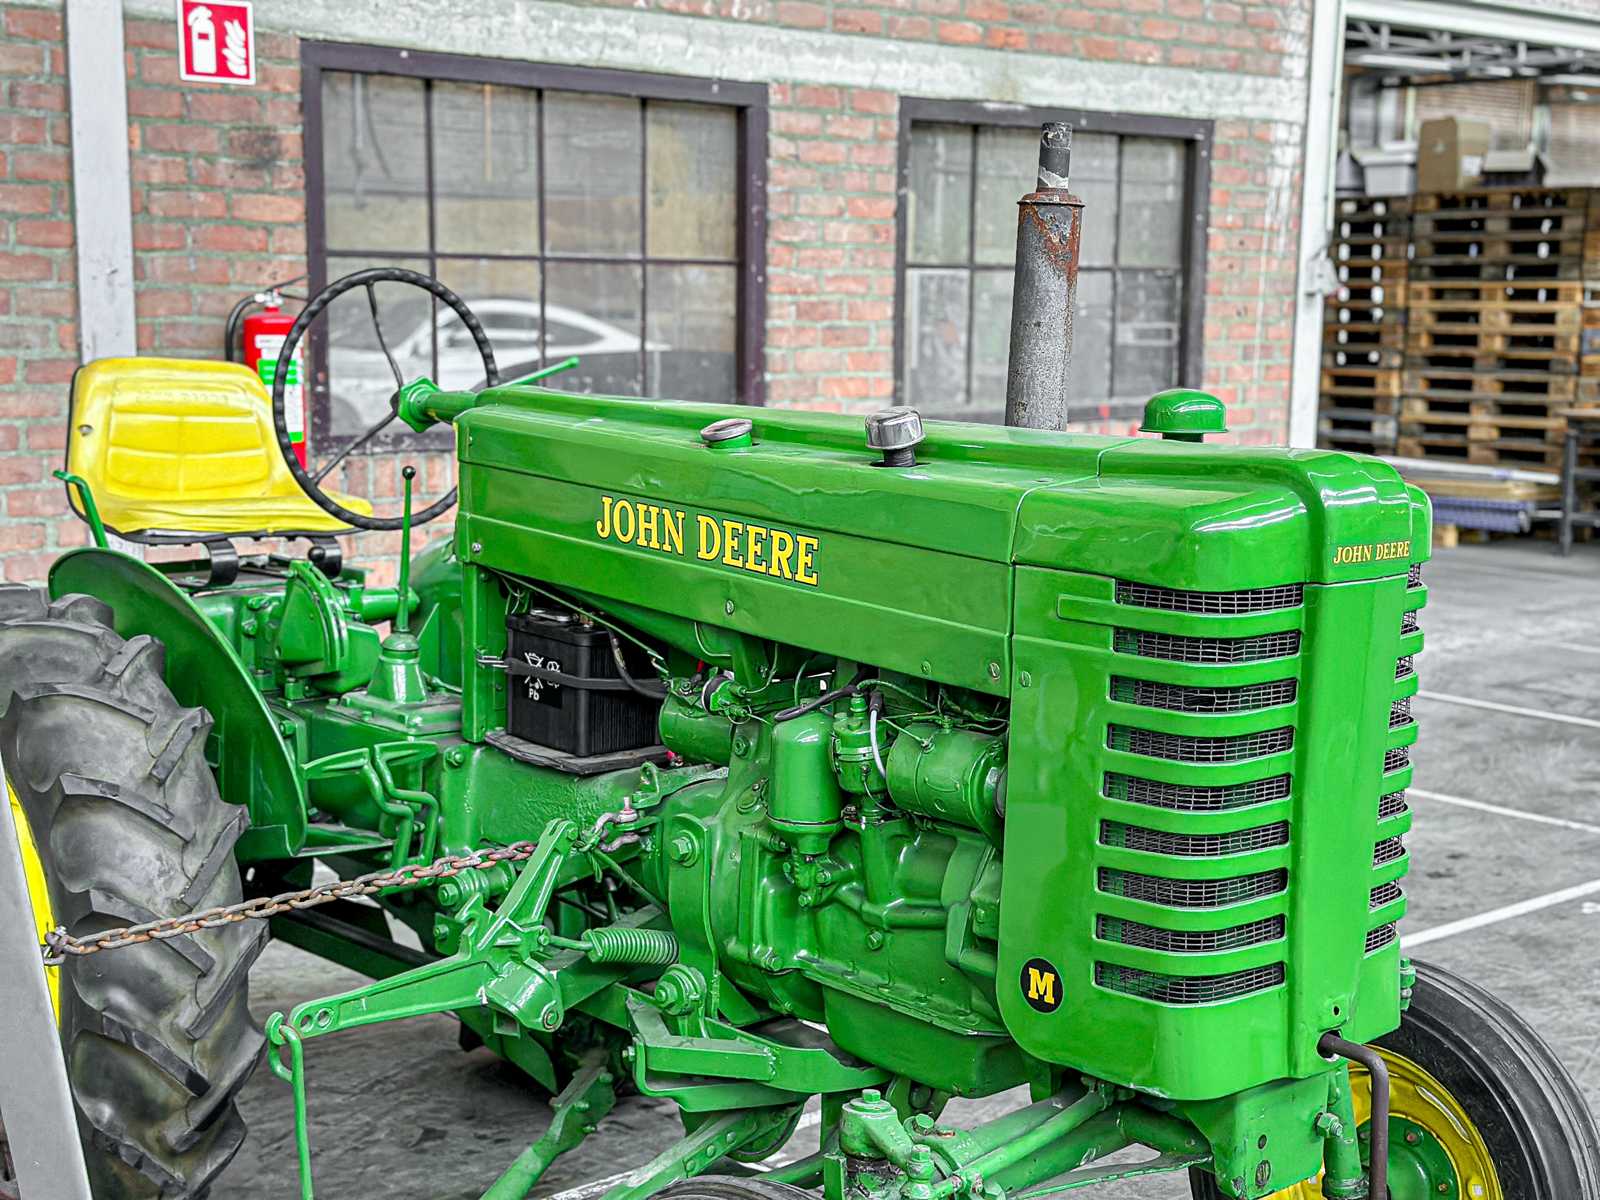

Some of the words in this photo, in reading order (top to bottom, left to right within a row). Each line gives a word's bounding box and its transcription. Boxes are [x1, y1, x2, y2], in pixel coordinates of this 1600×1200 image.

[596, 495, 686, 556] JOHN
[696, 514, 820, 586] DEERE
[1334, 544, 1372, 564] JOHN
[1376, 541, 1410, 560] DEERE
[529, 688, 539, 701] Pb
[1028, 967, 1055, 1005] M
